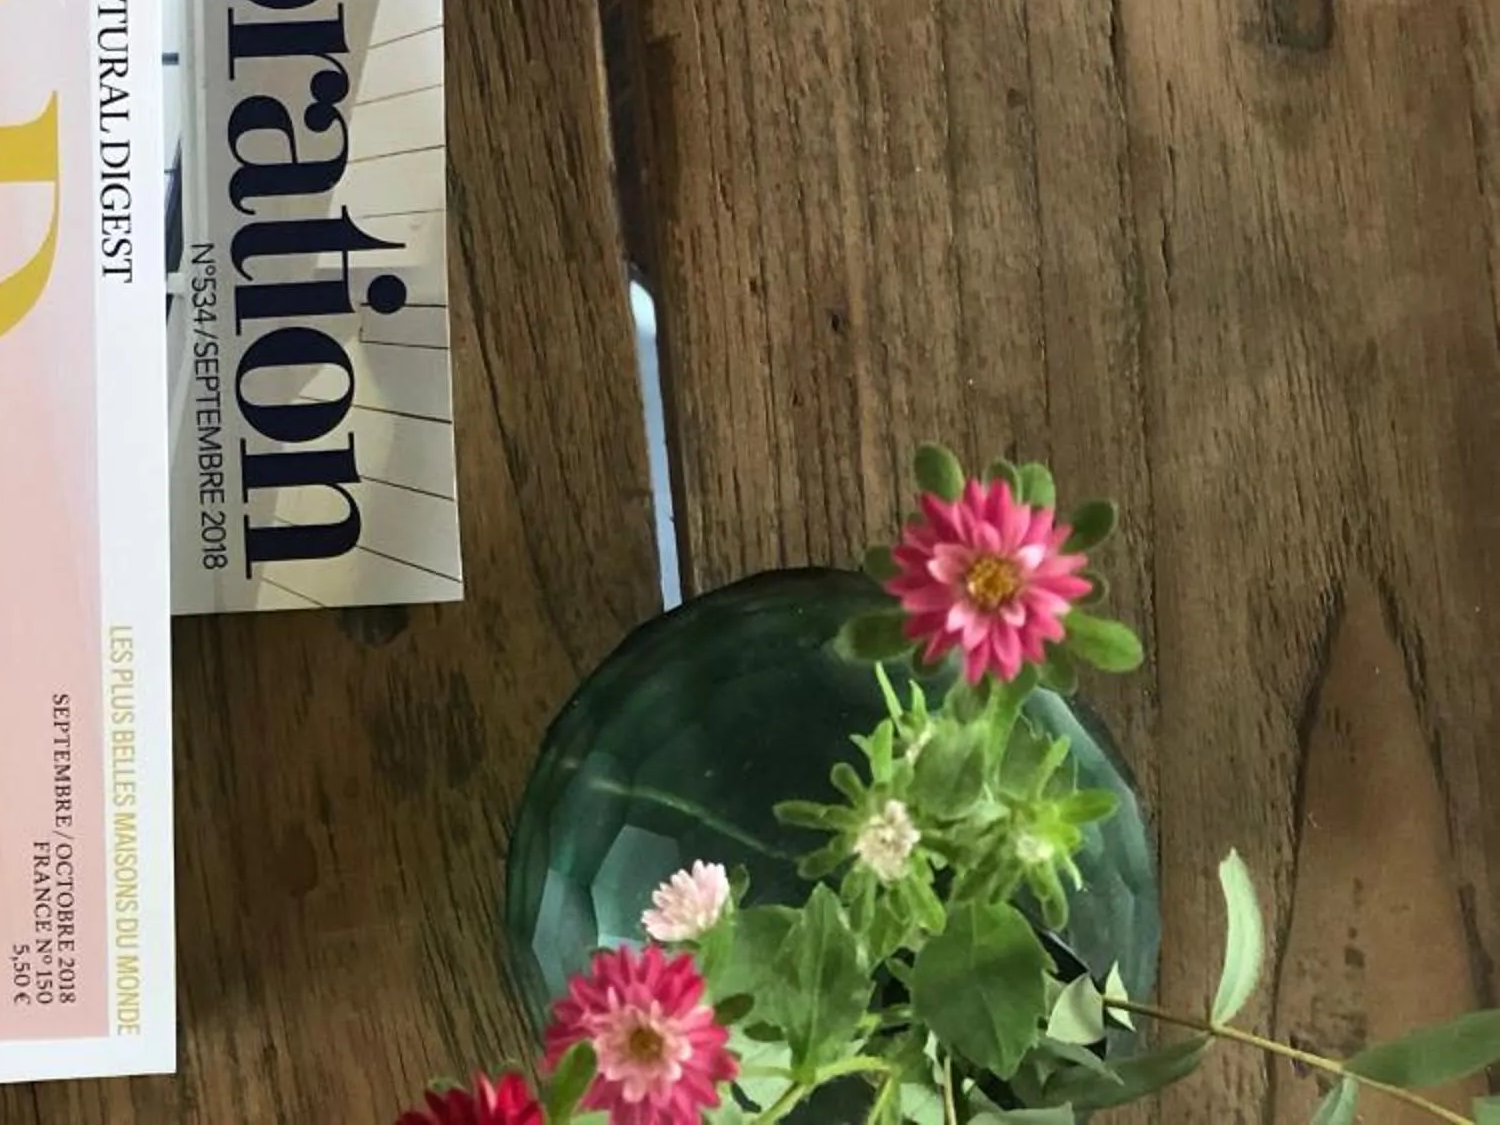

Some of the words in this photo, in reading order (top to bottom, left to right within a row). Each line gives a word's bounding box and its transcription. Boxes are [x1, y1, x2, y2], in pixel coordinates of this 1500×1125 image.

[97, 138, 134, 286] DIGEST
[201, 510, 229, 571] 2018
[107, 625, 135, 664] LES
[109, 668, 136, 724] PLUS
[111, 729, 137, 808] BELLES
[33, 841, 53, 933] FRANCE
[112, 812, 138, 912] MAISONS
[114, 917, 139, 949] DU
[8, 944, 30, 988] 5,50
[35, 970, 54, 1005] 150
[57, 957, 77, 1004] 2018
[12, 991, 31, 1006] €
[115, 954, 141, 1036] MONDE
